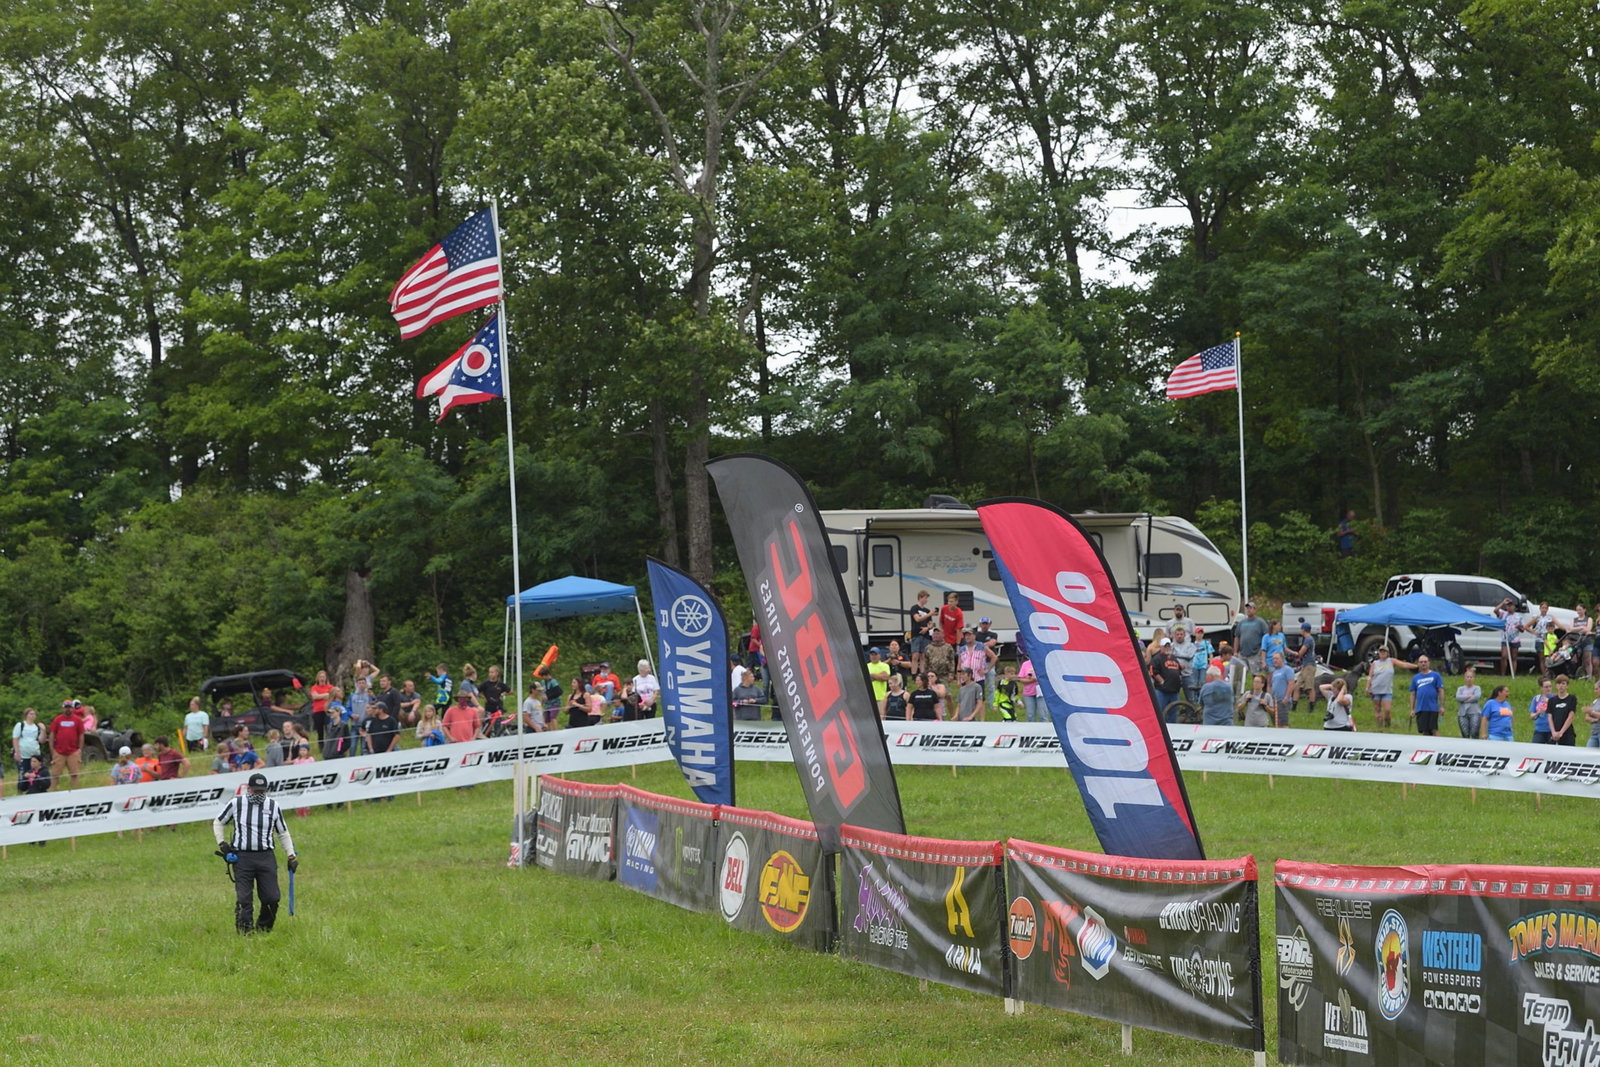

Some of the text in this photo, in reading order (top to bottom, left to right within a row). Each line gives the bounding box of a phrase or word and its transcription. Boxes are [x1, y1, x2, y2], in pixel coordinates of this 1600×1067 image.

[660, 608, 677, 746] RACIN
[1017, 571, 1164, 819] 100%
[675, 639, 717, 788] YAMAHA
[601, 731, 668, 750] WISEC
[735, 731, 790, 744] ISECO
[918, 735, 987, 747] WISECO
[1018, 736, 1063, 749] WISE
[487, 743, 564, 763] WISECO
[1224, 741, 1295, 756] WISECO
[1327, 746, 1402, 763] WISECO
[375, 758, 450, 779] WISECO
[1435, 752, 1511, 771] WISECO
[148, 788, 225, 807] WISECO
[38, 801, 113, 822] WISECO
[724, 856, 744, 894] BELL
[1197, 902, 1240, 933] RACING
[1508, 912, 1600, 961] TOM'S MAR
[1422, 930, 1482, 972] WESTFIELD
[1423, 972, 1481, 988] POWERSPORTS
[1534, 961, 1600, 983] SALES & SERVICE
[1325, 1002, 1368, 1038] VET TIX
[1525, 998, 1570, 1022] TEAM
